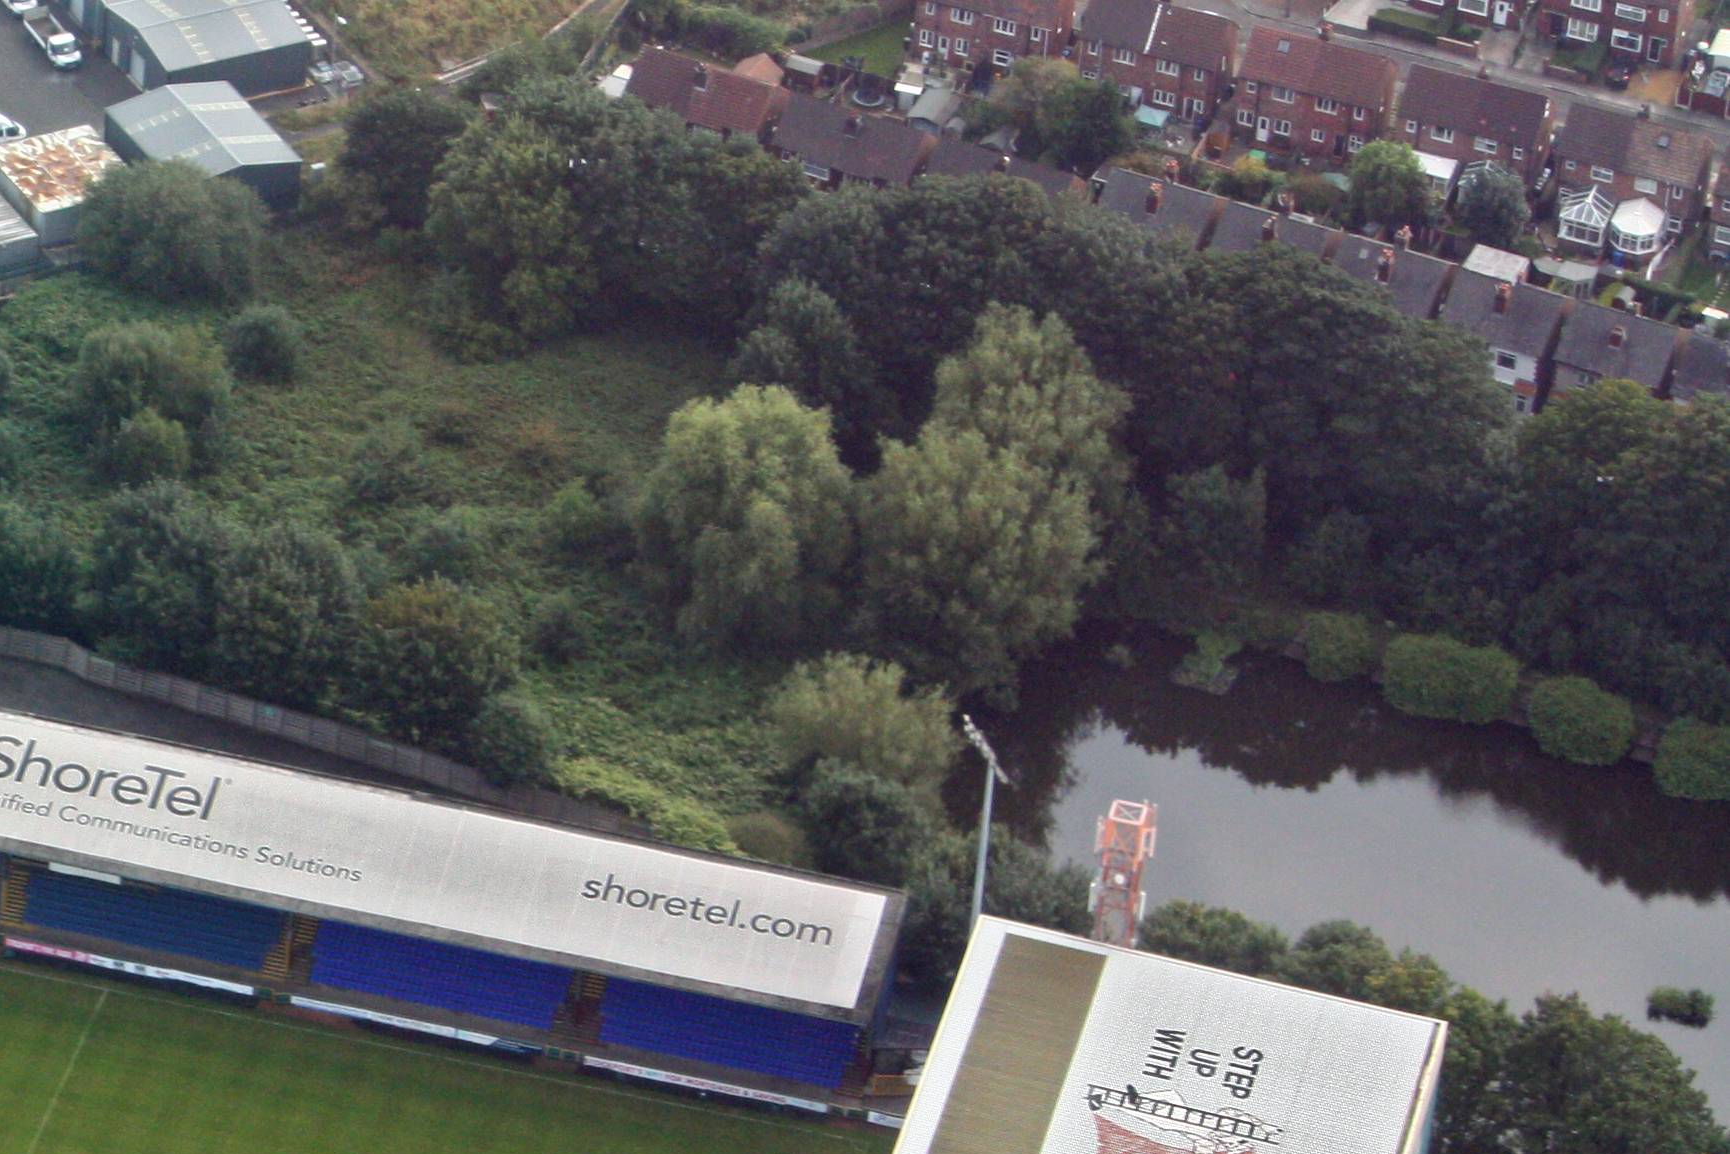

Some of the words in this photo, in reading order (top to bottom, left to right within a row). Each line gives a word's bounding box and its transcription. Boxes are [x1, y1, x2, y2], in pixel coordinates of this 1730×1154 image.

[58, 805, 249, 860] Communications
[255, 846, 363, 883] Solutions
[581, 873, 833, 946] shoretel.com
[1142, 1028, 1187, 1080] WITH
[1187, 1048, 1222, 1078] UP
[1221, 1046, 1264, 1100] STEP
